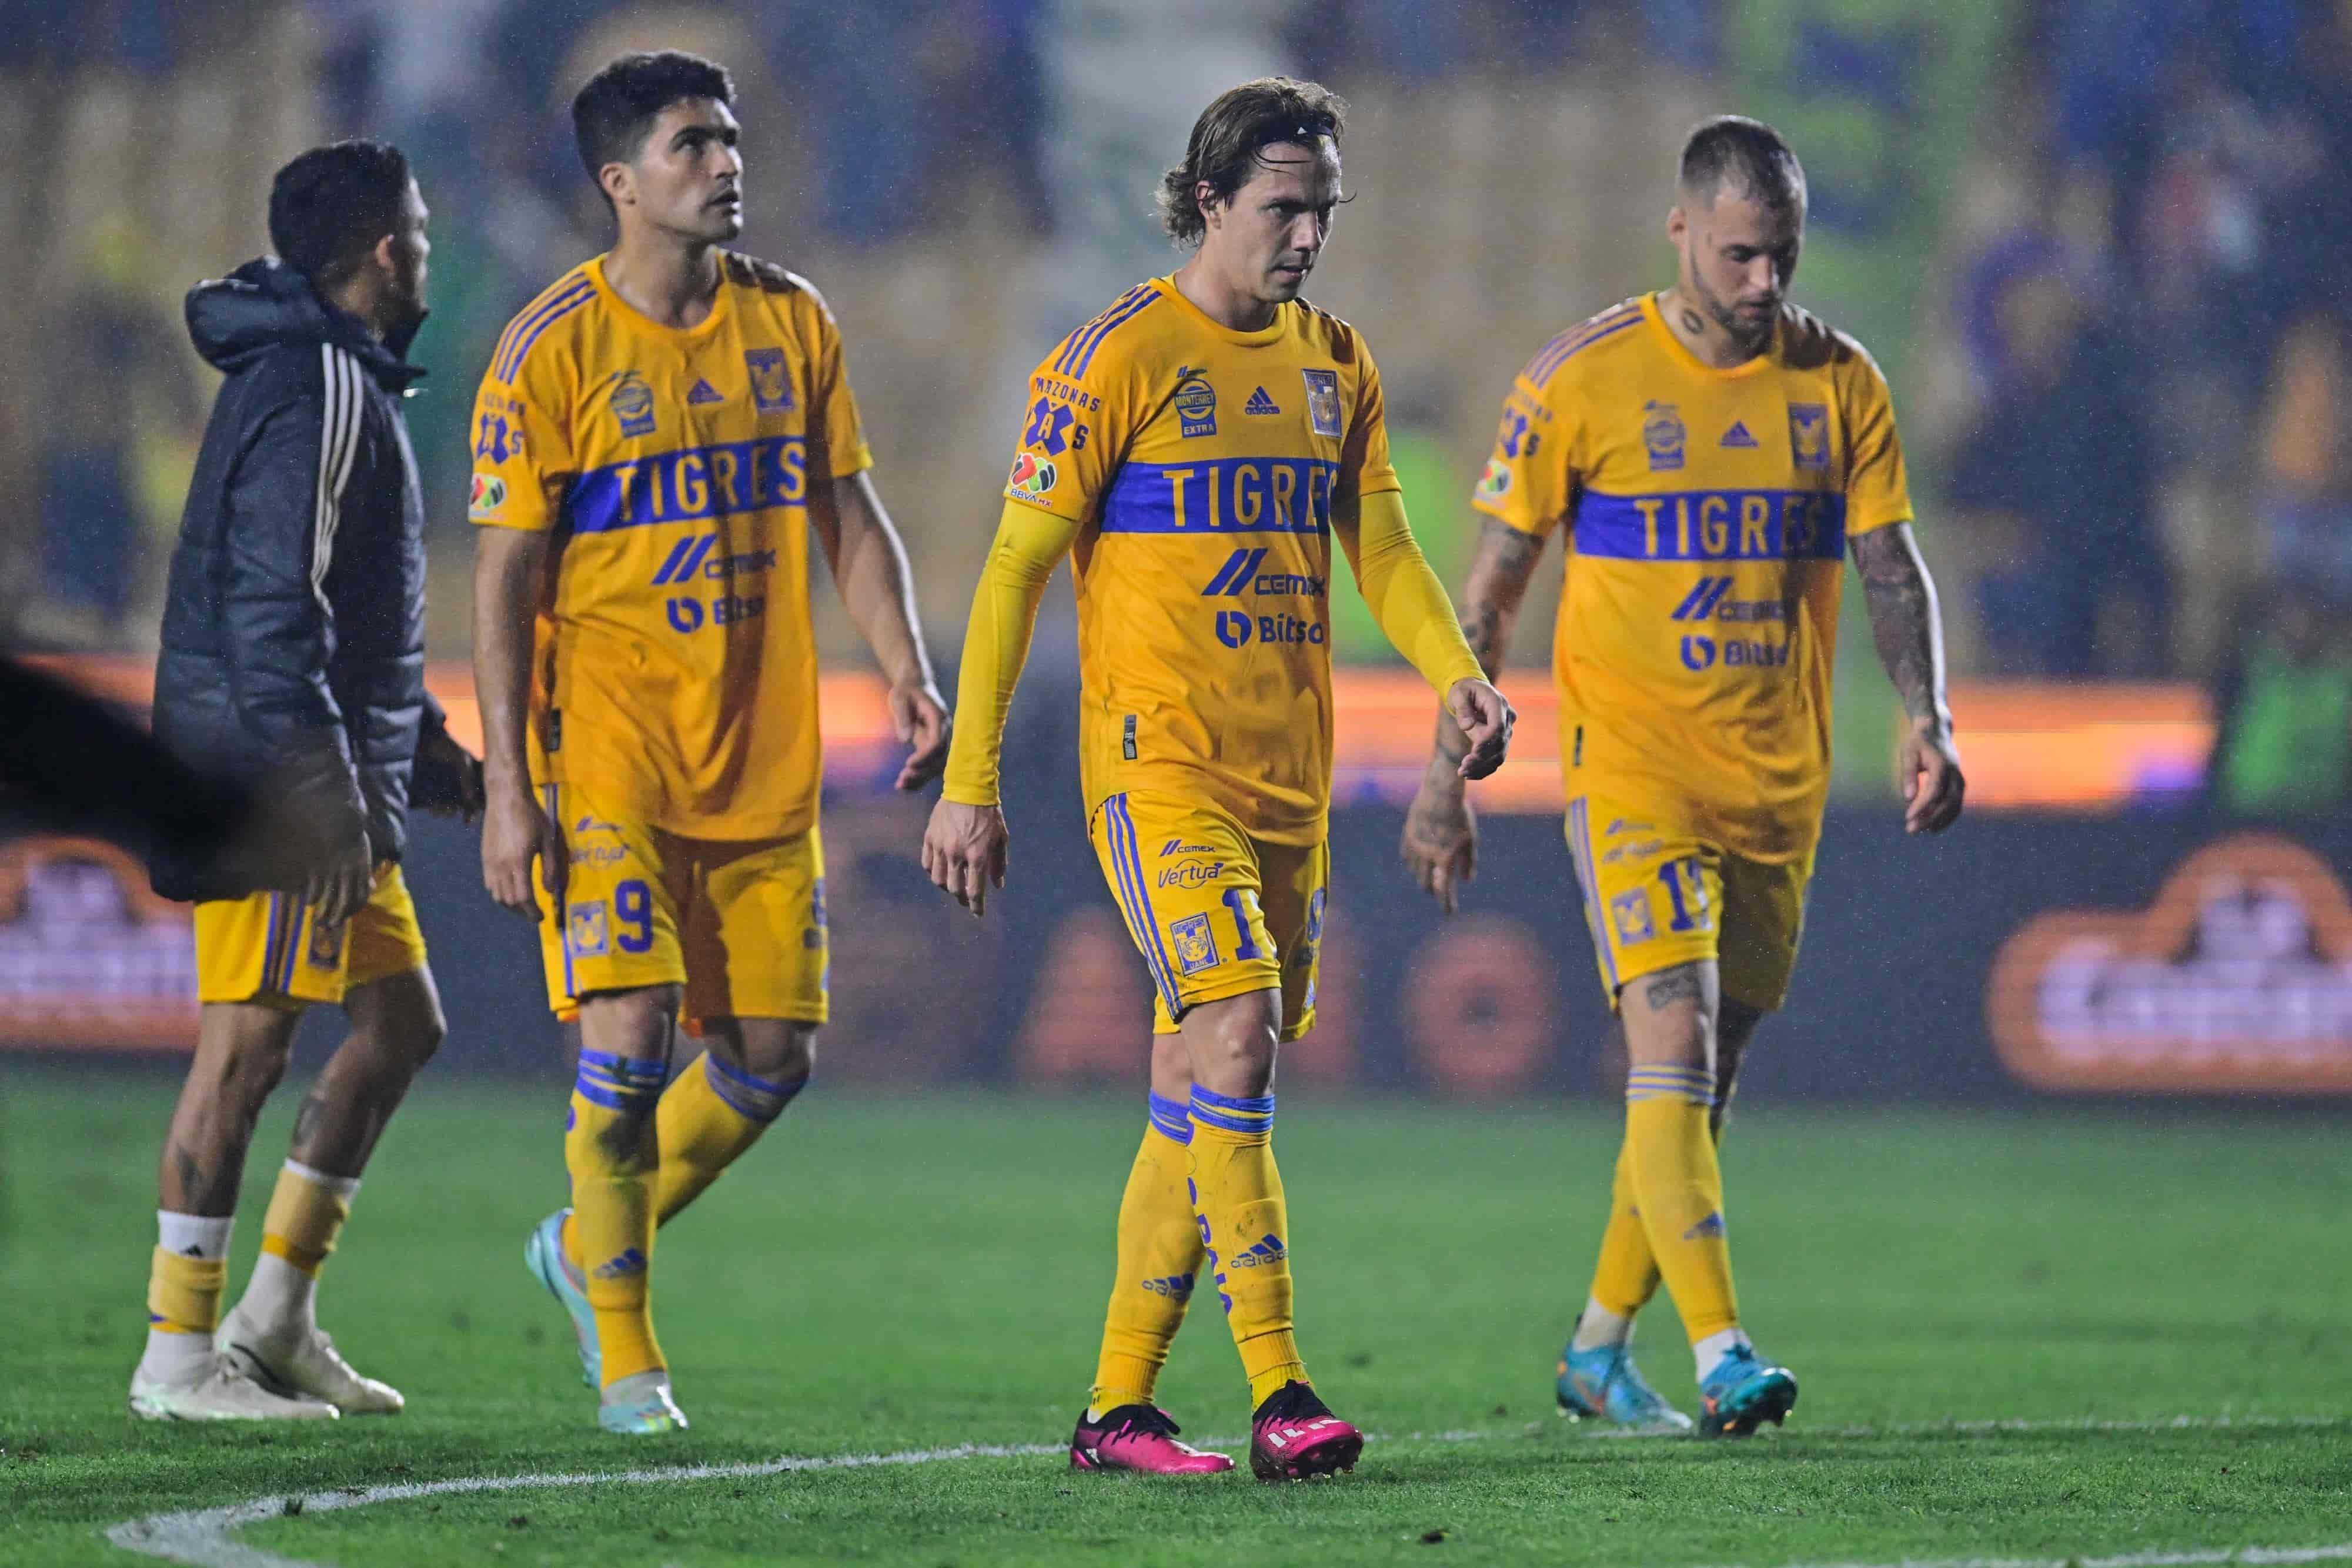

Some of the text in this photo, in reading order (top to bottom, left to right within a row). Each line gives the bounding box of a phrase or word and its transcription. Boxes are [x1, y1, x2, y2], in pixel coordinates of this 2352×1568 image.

[1184, 423, 1214, 434] EXTRA
[614, 441, 804, 523] TIGRES
[1258, 613, 1324, 644] Bitso
[1158, 862, 1224, 888] Vertua
[615, 880, 654, 953] 9
[1175, 916, 1205, 934] TIGRES
